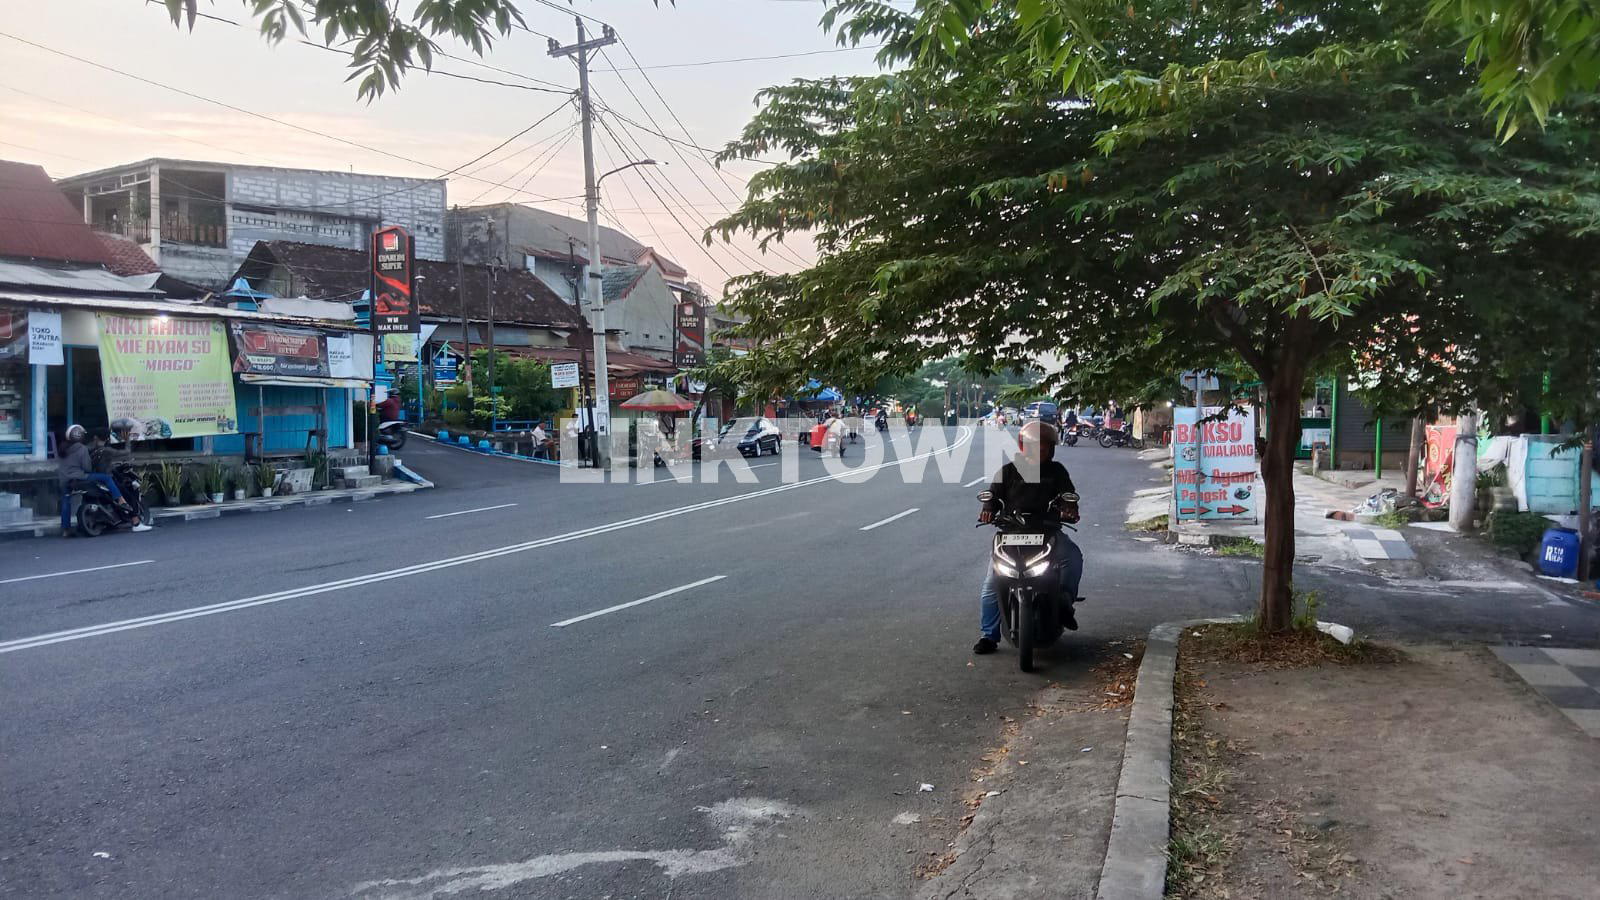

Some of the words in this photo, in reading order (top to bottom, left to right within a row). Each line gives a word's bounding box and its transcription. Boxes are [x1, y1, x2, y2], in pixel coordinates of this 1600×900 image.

[116, 339, 142, 354] MIE
[146, 340, 188, 354] AYAM
[1176, 422, 1242, 444] BAKSU
[1203, 444, 1254, 457] MALANG
[1211, 468, 1255, 487] Ayam
[1181, 489, 1228, 504] Pangsit
